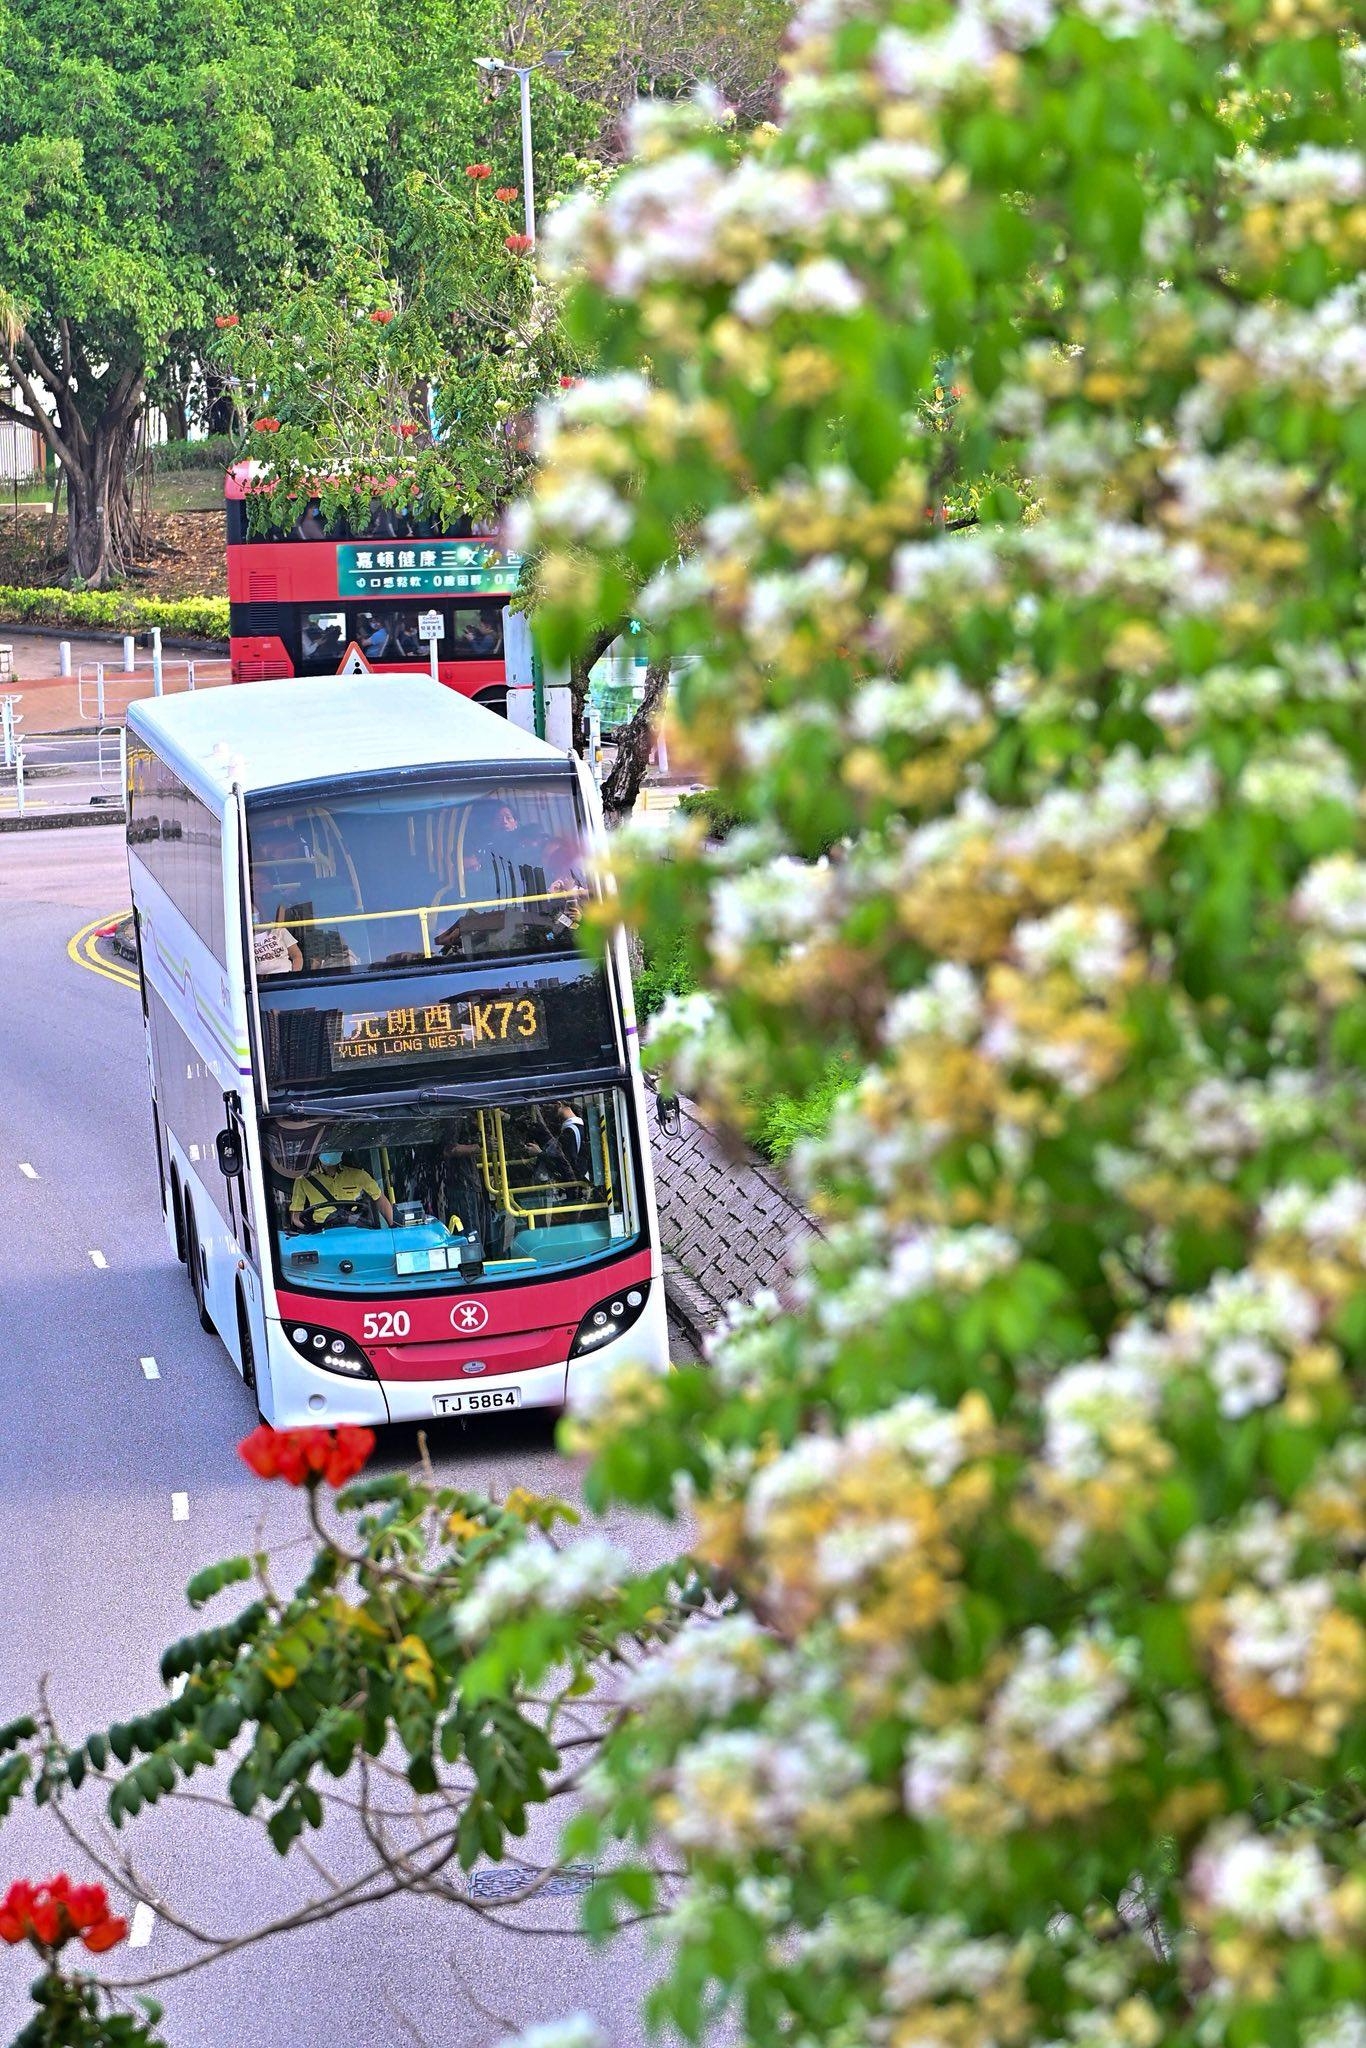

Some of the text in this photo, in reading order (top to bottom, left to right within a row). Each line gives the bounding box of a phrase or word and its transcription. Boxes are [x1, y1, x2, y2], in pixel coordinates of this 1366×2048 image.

[254, 941, 278, 955] BETTER
[348, 1004, 452, 1041] 元朗西
[473, 999, 537, 1041] K73
[338, 1032, 467, 1059] YUEN LONG WEST
[363, 1310, 411, 1340] 520
[438, 1391, 516, 1413] TJ 5864
